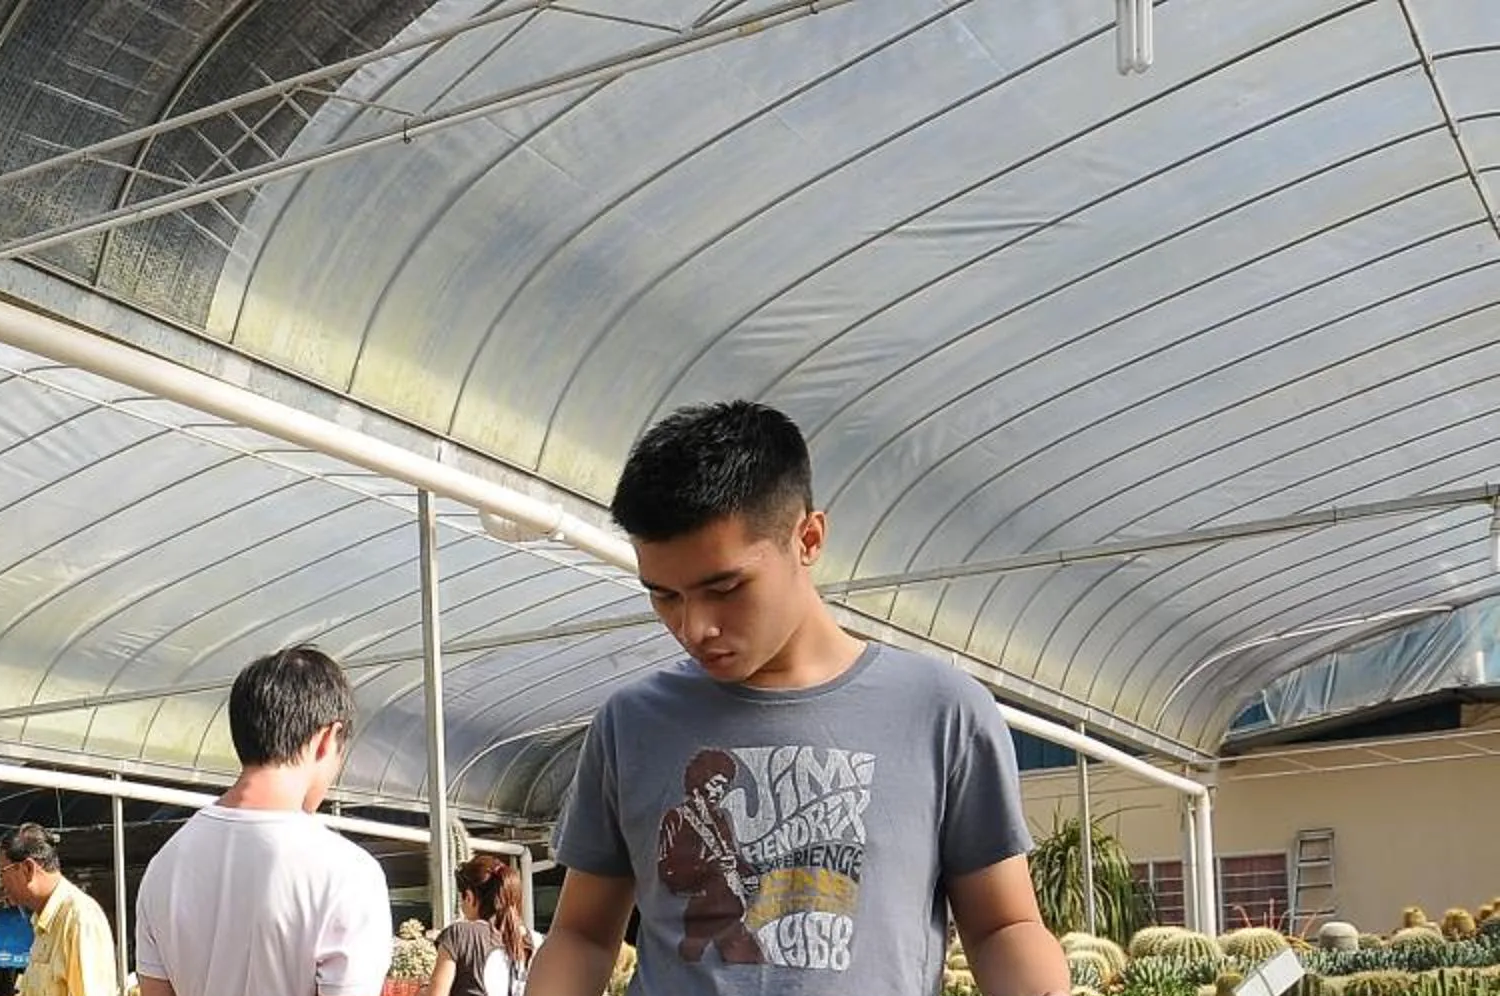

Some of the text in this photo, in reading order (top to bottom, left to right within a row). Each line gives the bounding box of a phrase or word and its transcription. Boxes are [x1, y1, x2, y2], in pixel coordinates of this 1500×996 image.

[720, 745, 876, 844] JIMI
[742, 789, 871, 865] HENDRIX
[758, 911, 853, 971] 1968
